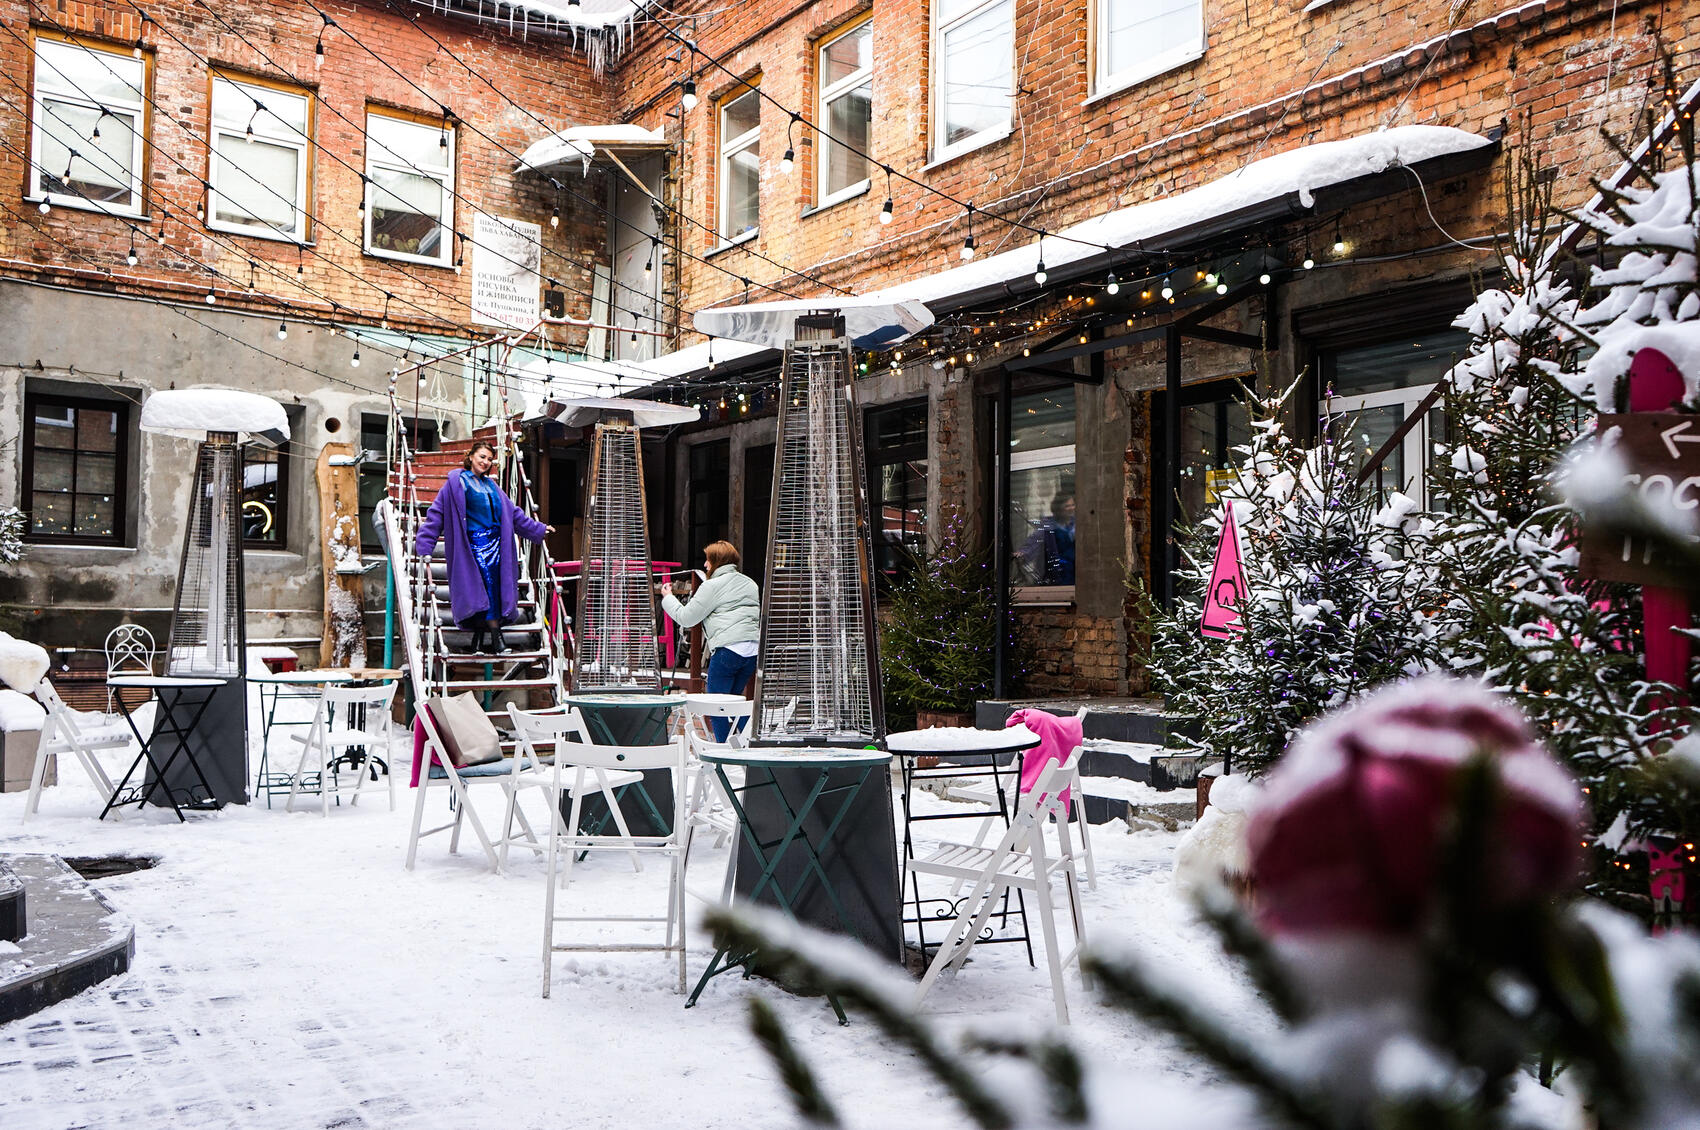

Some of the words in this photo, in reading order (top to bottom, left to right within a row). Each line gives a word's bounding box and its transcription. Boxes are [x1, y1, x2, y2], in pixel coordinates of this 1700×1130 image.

[477, 272, 514, 284] ОСНОВЫ
[478, 280, 517, 293] РИСУНКА
[486, 291, 535, 304] ЖИВОПИСИ
